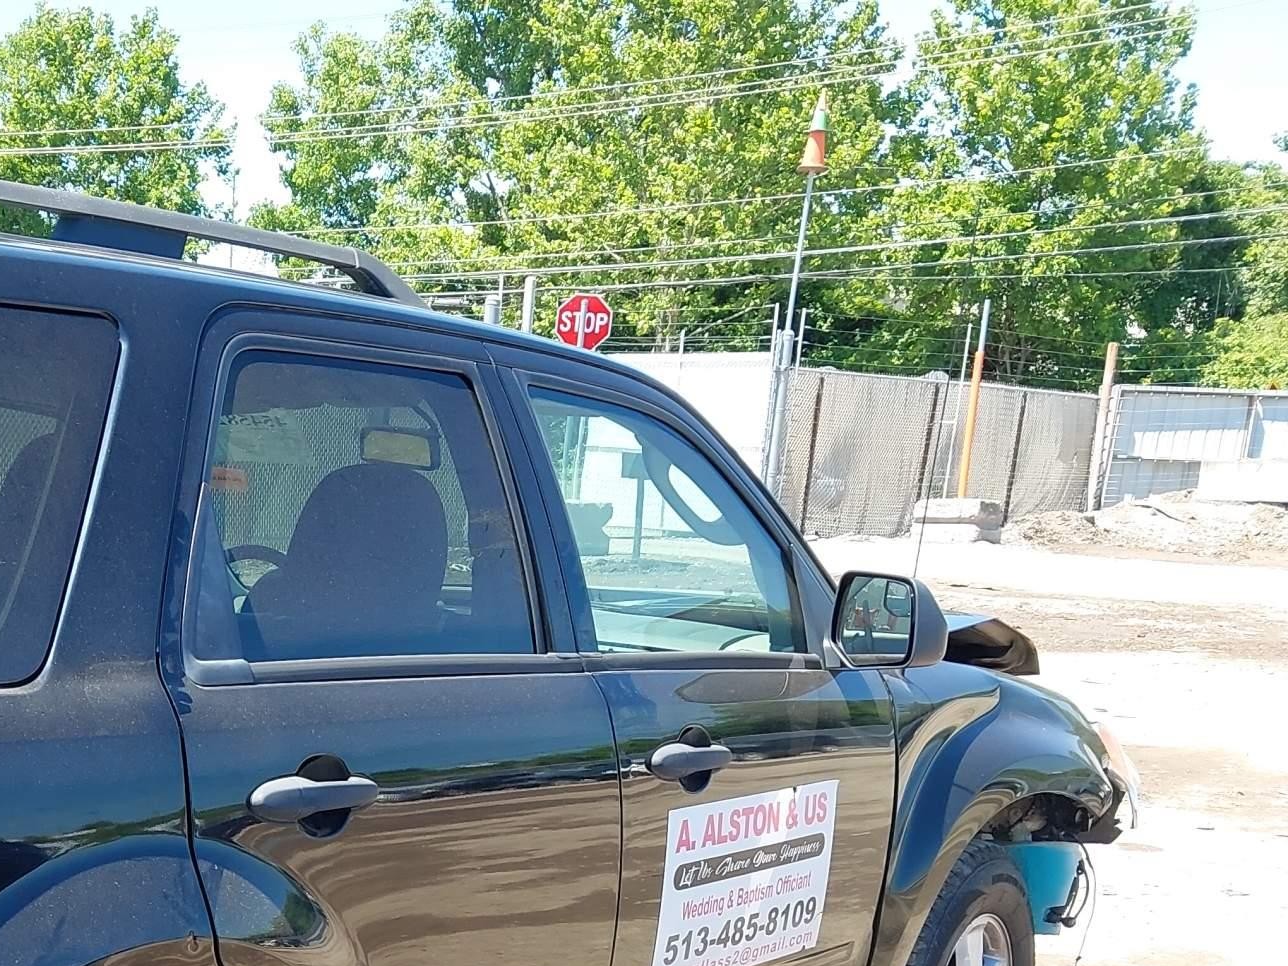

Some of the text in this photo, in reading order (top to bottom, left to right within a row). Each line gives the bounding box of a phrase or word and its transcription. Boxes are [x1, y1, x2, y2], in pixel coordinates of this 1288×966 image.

[559, 310, 608, 334] STOP
[675, 791, 828, 854] A. ALSTON & US
[679, 864, 696, 887] Let
[715, 857, 751, 876] Share
[753, 850, 777, 868] Your
[780, 840, 821, 862] Happiness
[682, 873, 812, 920] Wedding & Baptism Officiant
[663, 896, 817, 966] 513-485-8109
